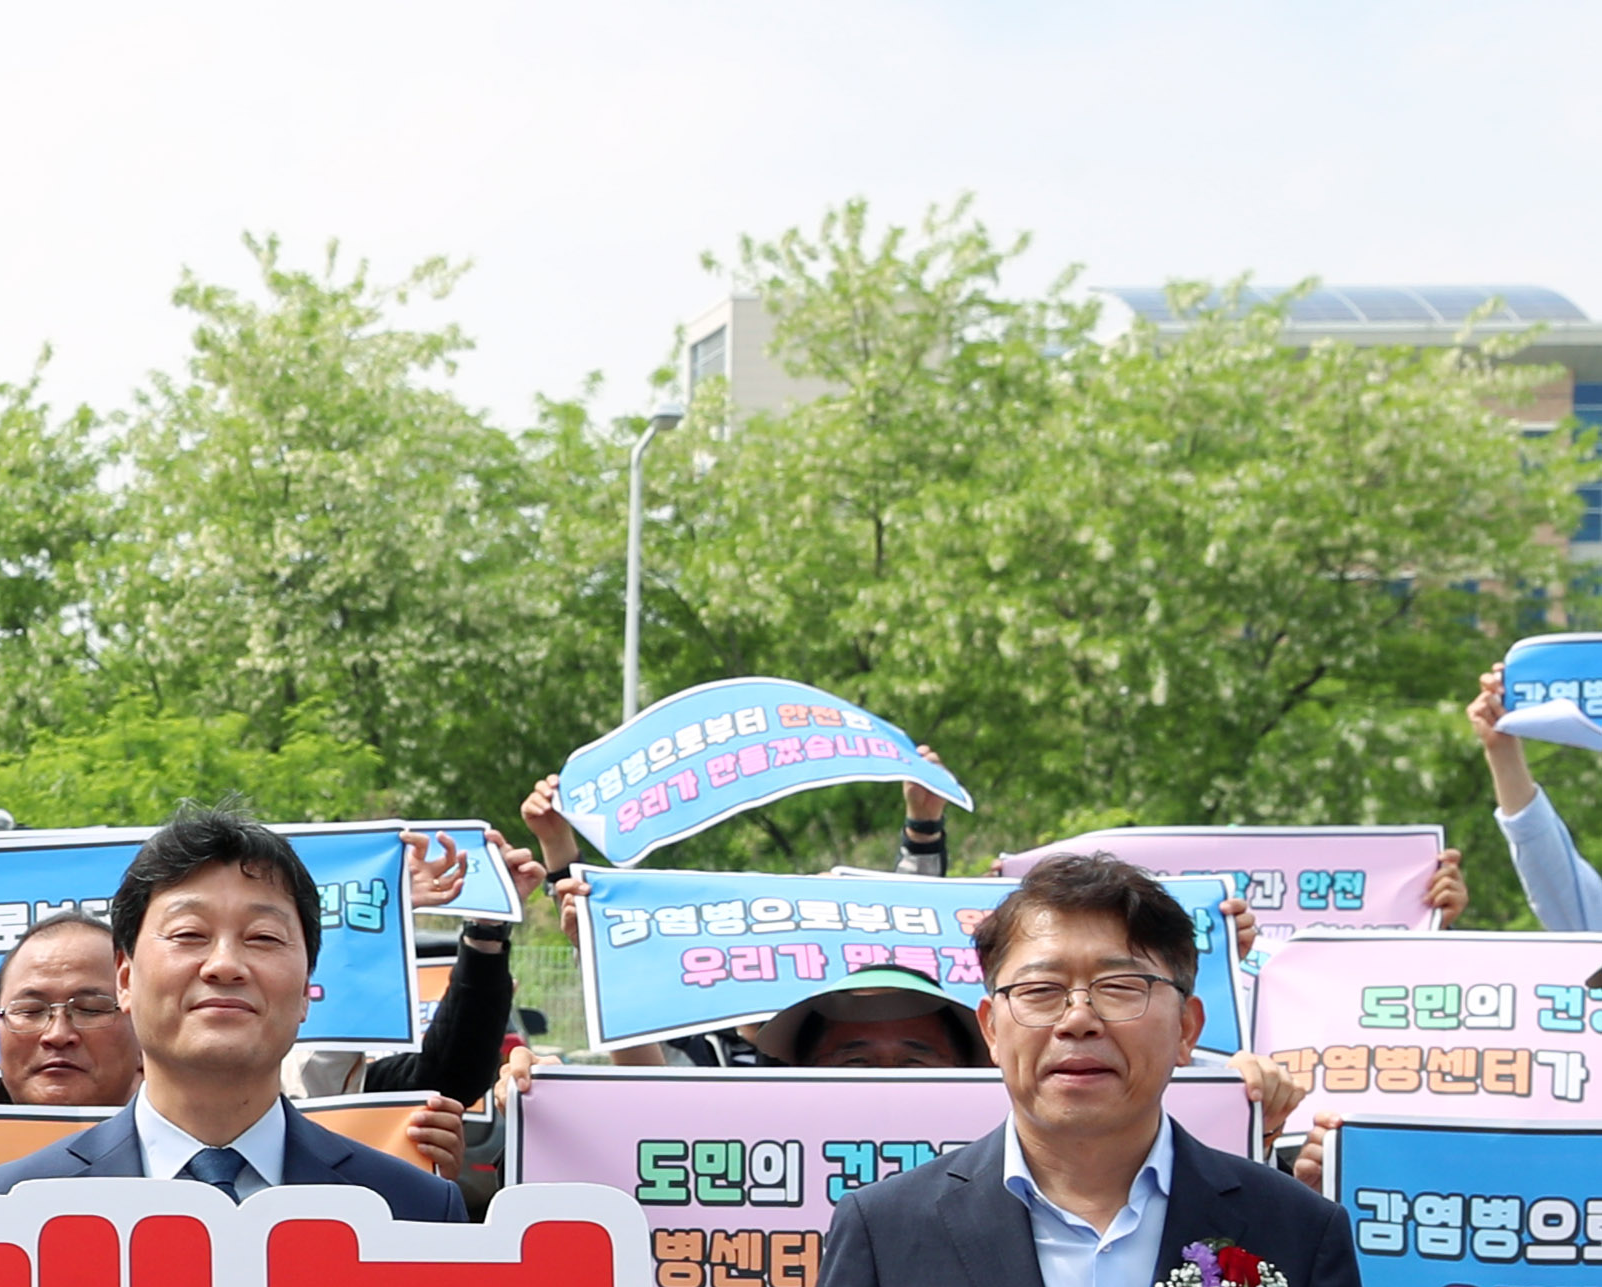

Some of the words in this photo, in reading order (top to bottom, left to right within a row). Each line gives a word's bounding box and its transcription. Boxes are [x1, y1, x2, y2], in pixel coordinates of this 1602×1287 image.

[616, 769, 699, 834] 우리가
[705, 735, 910, 790] 만들겠습니다.
[1297, 870, 1366, 911] 안전
[602, 897, 942, 949] 감염병으로부터
[680, 943, 828, 988] 우리가
[1358, 983, 1516, 1031] 도민의
[1534, 984, 1602, 1033] 건
[635, 1140, 804, 1207] 도민의
